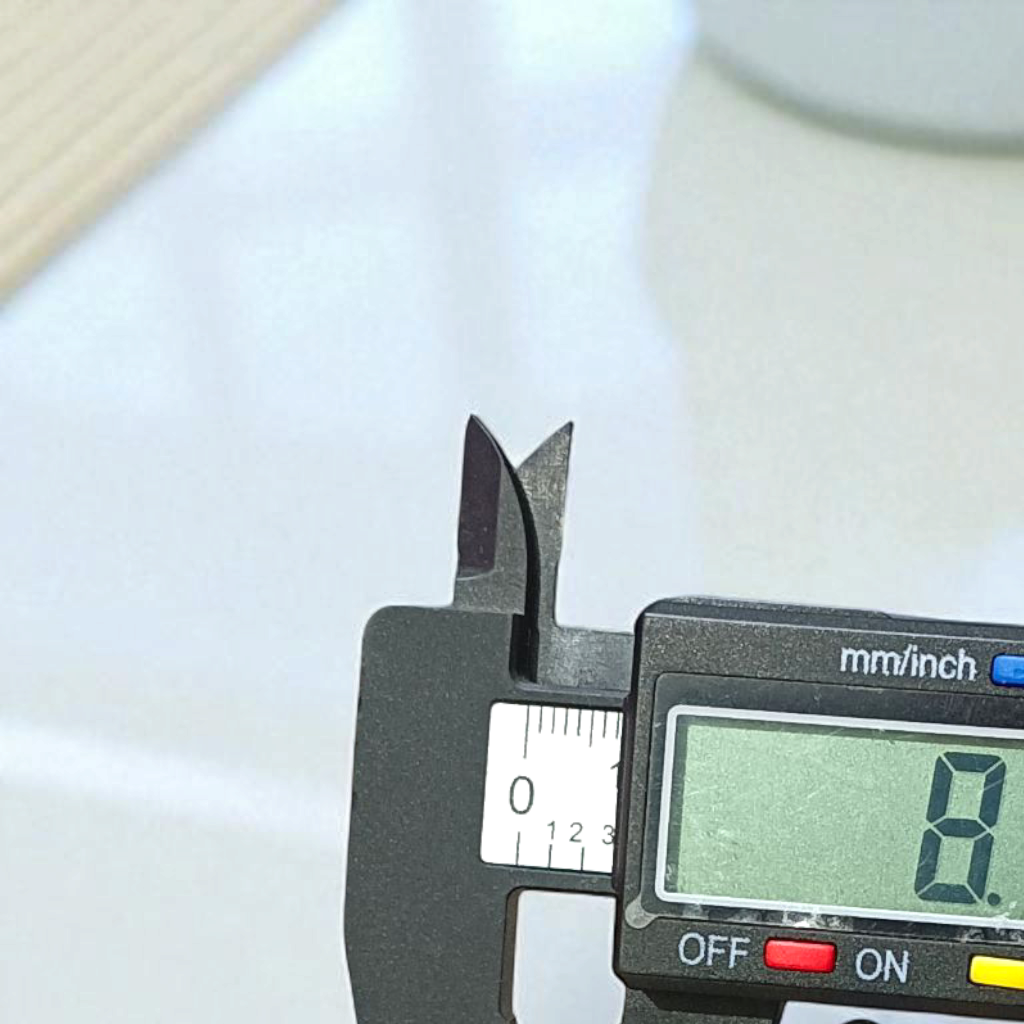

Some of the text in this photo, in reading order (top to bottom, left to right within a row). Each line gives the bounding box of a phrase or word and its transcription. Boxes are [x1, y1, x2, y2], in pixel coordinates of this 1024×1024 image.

[840, 643, 978, 682] mm/inch
[509, 775, 535, 815] 0
[547, 820, 616, 845] 1 2 3
[677, 932, 751, 969] OFF
[855, 948, 910, 984] ON
